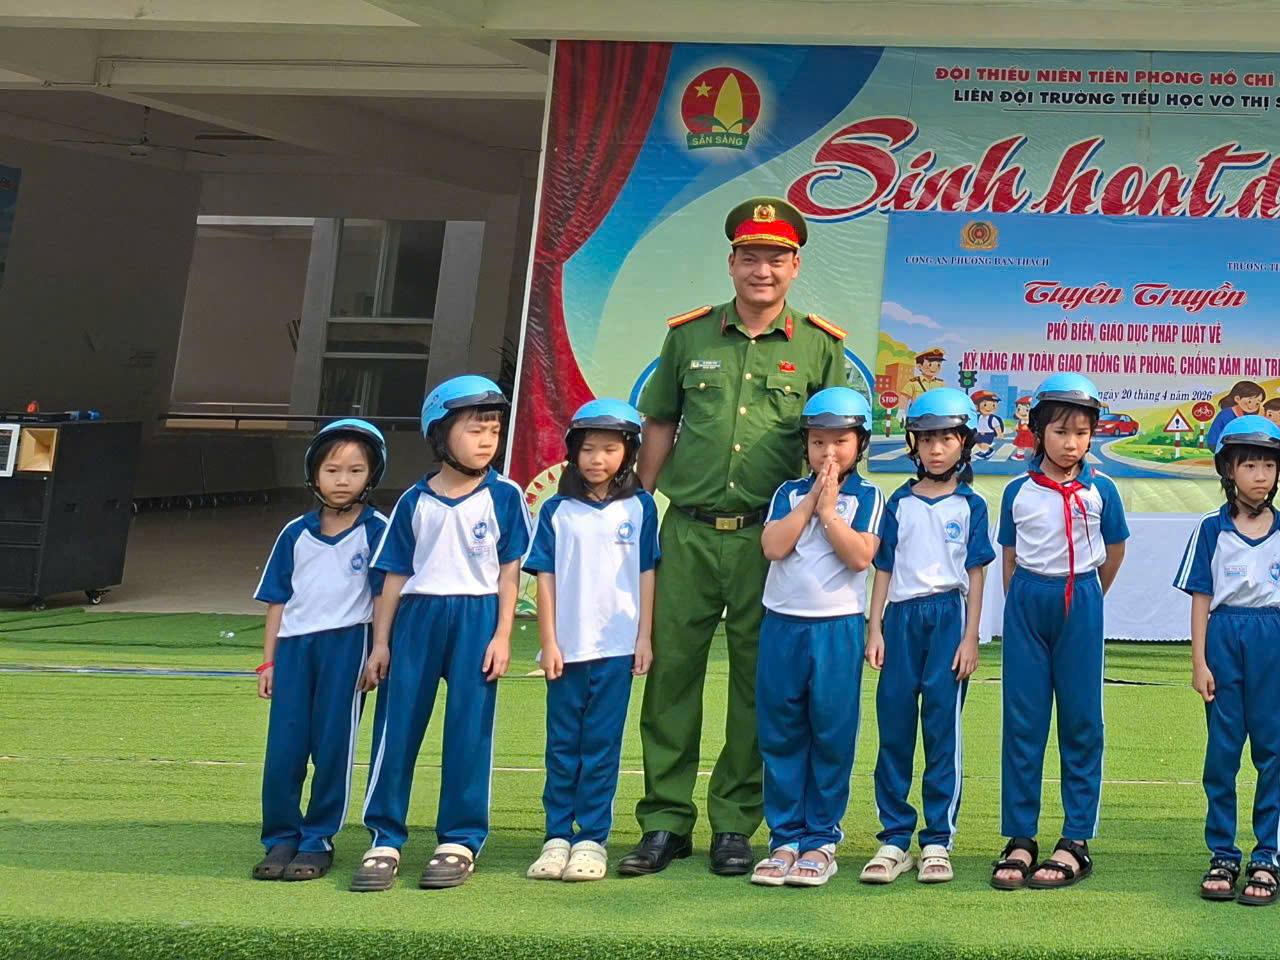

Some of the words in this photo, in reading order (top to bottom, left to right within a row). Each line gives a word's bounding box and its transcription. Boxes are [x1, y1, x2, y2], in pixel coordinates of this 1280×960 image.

[935, 65, 970, 83] ĐỘI
[976, 64, 1030, 82] THIẾU
[1036, 68, 1082, 83] NIÊN
[1088, 66, 1128, 83] TIỀN
[1135, 71, 1203, 85] PHONG
[1210, 69, 1237, 85] HỒ
[1243, 71, 1274, 87] CHÍ
[954, 88, 994, 102] LIÊN
[1000, 90, 1033, 106] ĐỘI
[1040, 90, 1116, 105] TRƯỜNG
[1121, 89, 1160, 105] TIỂU
[1166, 93, 1204, 109] HỌC
[1241, 95, 1269, 111] THỊ
[787, 115, 1031, 223] Sinh
[1024, 281, 1123, 310] Tuyên
[1134, 281, 1247, 313] Truyền
[1127, 324, 1149, 346] DỤC
[1181, 322, 1206, 346] LUẬT
[1010, 353, 1025, 371] AN
[1058, 353, 1082, 372] GIAO
[1244, 358, 1262, 381] HẠI
[1121, 389, 1132, 399] 20
[1134, 389, 1160, 402] tháng
[1192, 390, 1213, 401] 2026
